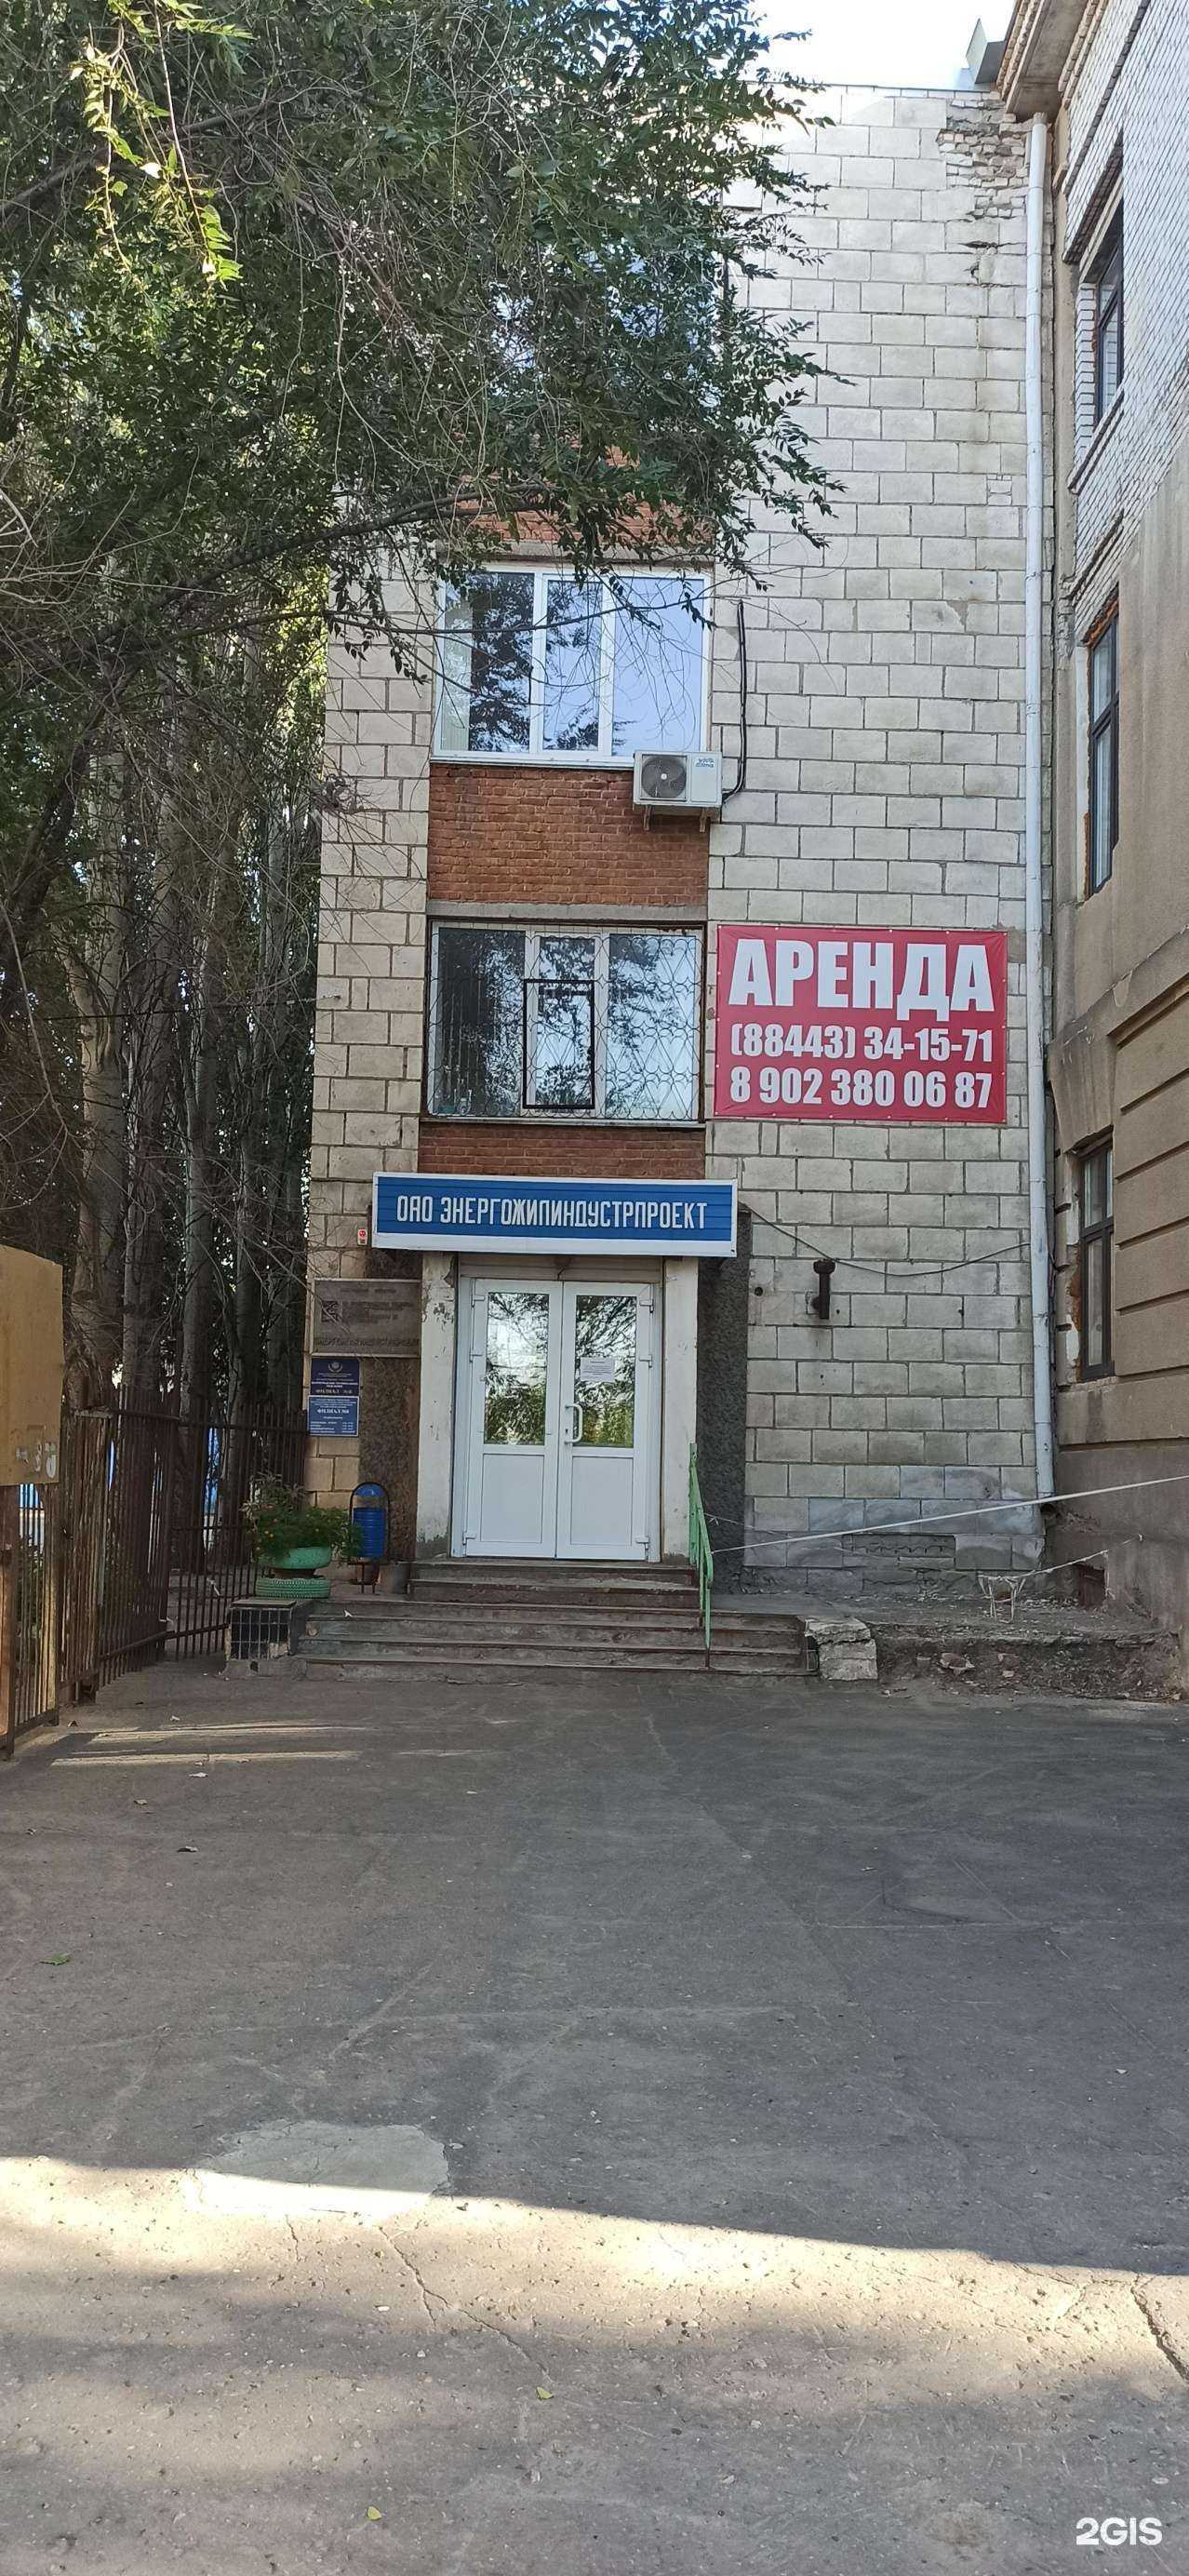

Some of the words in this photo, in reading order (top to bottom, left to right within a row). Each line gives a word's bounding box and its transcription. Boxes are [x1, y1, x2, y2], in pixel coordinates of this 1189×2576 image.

[728, 938, 995, 1022] АРЕНДА
[731, 1023, 855, 1059] (88443)
[863, 1026, 993, 1063] 34-15-71
[730, 1067, 751, 1104] 8
[759, 1067, 822, 1105] 902
[830, 1068, 895, 1107] 380
[903, 1070, 946, 1108] 06
[955, 1071, 993, 1108] 87
[396, 1195, 434, 1223] ОАО
